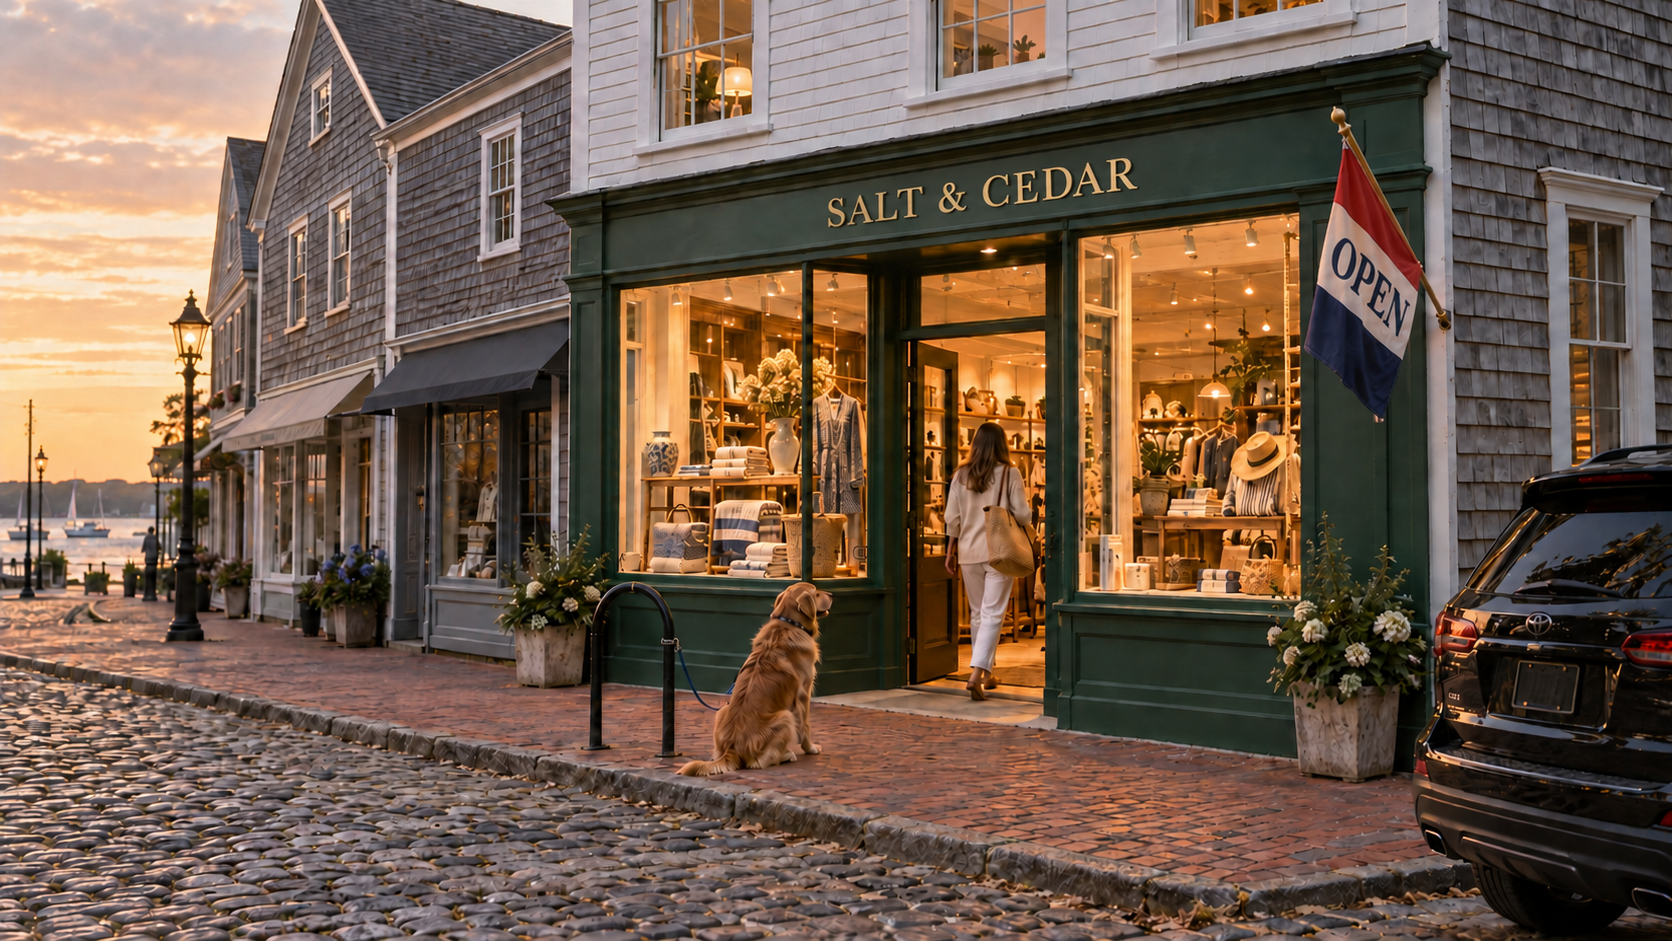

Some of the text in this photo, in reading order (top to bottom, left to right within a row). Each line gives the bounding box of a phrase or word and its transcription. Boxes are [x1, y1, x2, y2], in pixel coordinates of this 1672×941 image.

[827, 157, 1138, 228] SALT & CEDAR
[1331, 237, 1411, 338] OPEN
